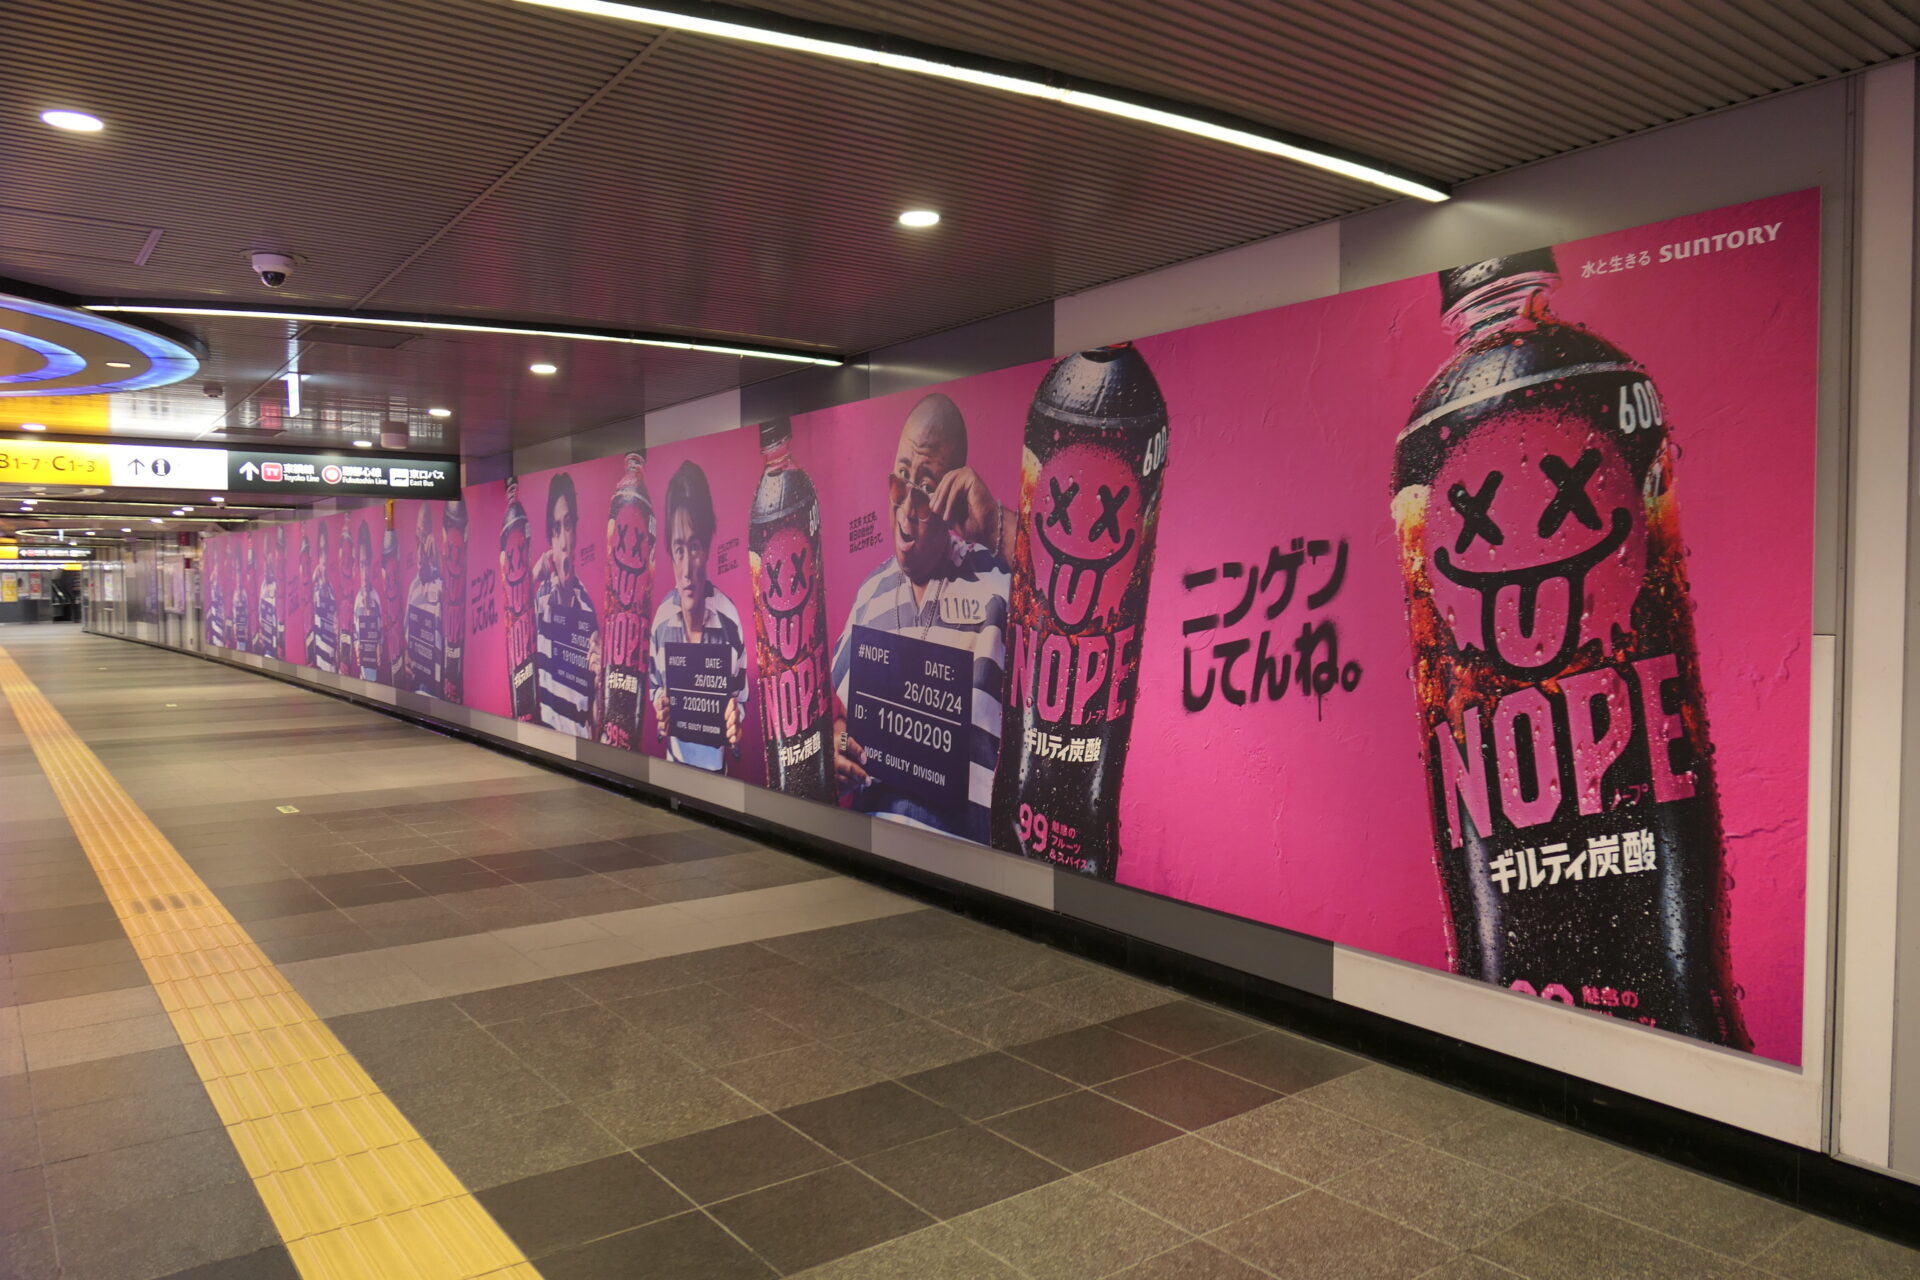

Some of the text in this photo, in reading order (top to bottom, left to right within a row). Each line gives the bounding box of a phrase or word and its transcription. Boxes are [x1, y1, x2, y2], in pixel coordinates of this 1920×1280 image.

[1581, 221, 1784, 279] 水と生きる SUNTORY
[1619, 379, 1663, 434] 600
[944, 596, 982, 620] 1102
[1182, 536, 1349, 637] ニンゲン
[694, 673, 728, 689] 26/03/24
[705, 657, 723, 669] DATE:
[858, 643, 955, 681] #NOPE DATE:
[1010, 624, 1136, 725] NOPE
[1182, 618, 1363, 714] してんね。
[683, 696, 720, 714] 22020111
[904, 681, 962, 715] 26/03/24
[854, 704, 868, 720] ID:
[878, 707, 952, 753] 11020209
[1023, 727, 1102, 763] ギルティ炭酸
[864, 746, 946, 787] NOPE GUILTY DIVISION
[1434, 653, 1696, 850] NOPE
[1019, 803, 1049, 852] 99
[1051, 834, 1082, 854] フルーツ
[1488, 828, 1658, 894] ギルティ炭酸
